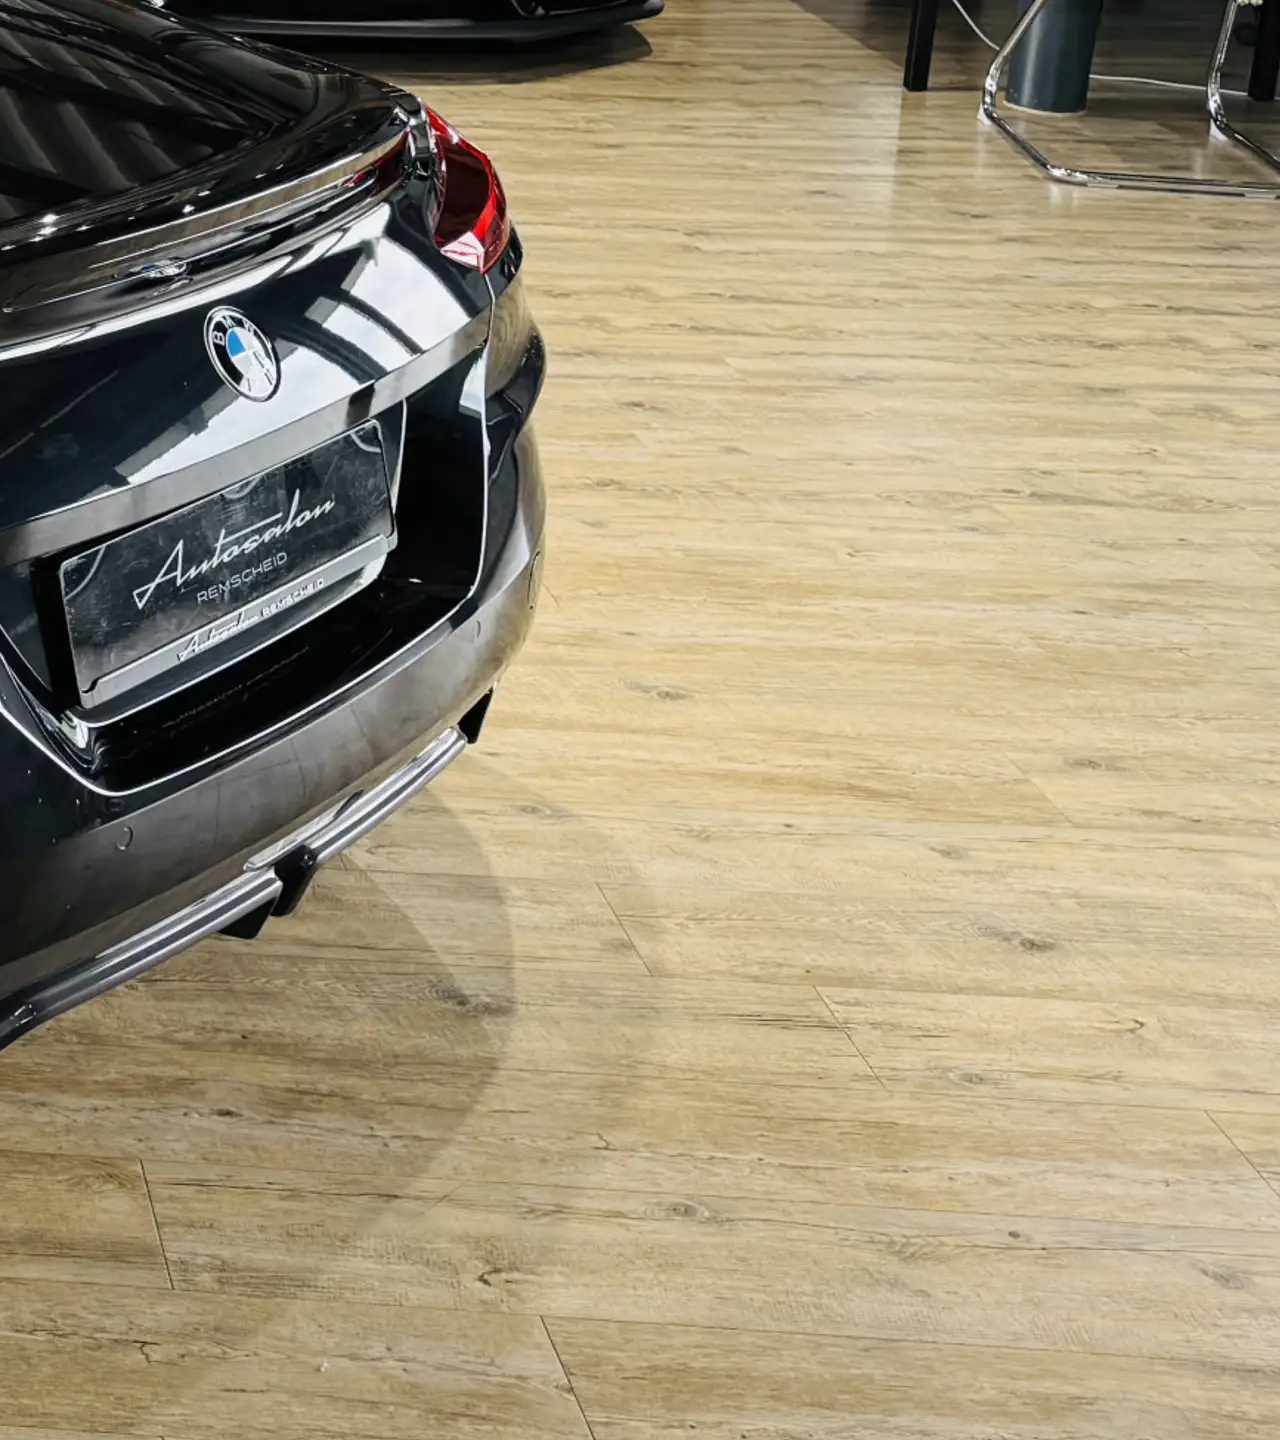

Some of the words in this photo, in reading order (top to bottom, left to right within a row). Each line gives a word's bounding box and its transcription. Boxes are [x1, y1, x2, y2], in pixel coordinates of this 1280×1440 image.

[132, 488, 336, 609] Autosalon
[196, 551, 288, 604] REMSCHEID
[261, 578, 325, 618] REMSCHEID
